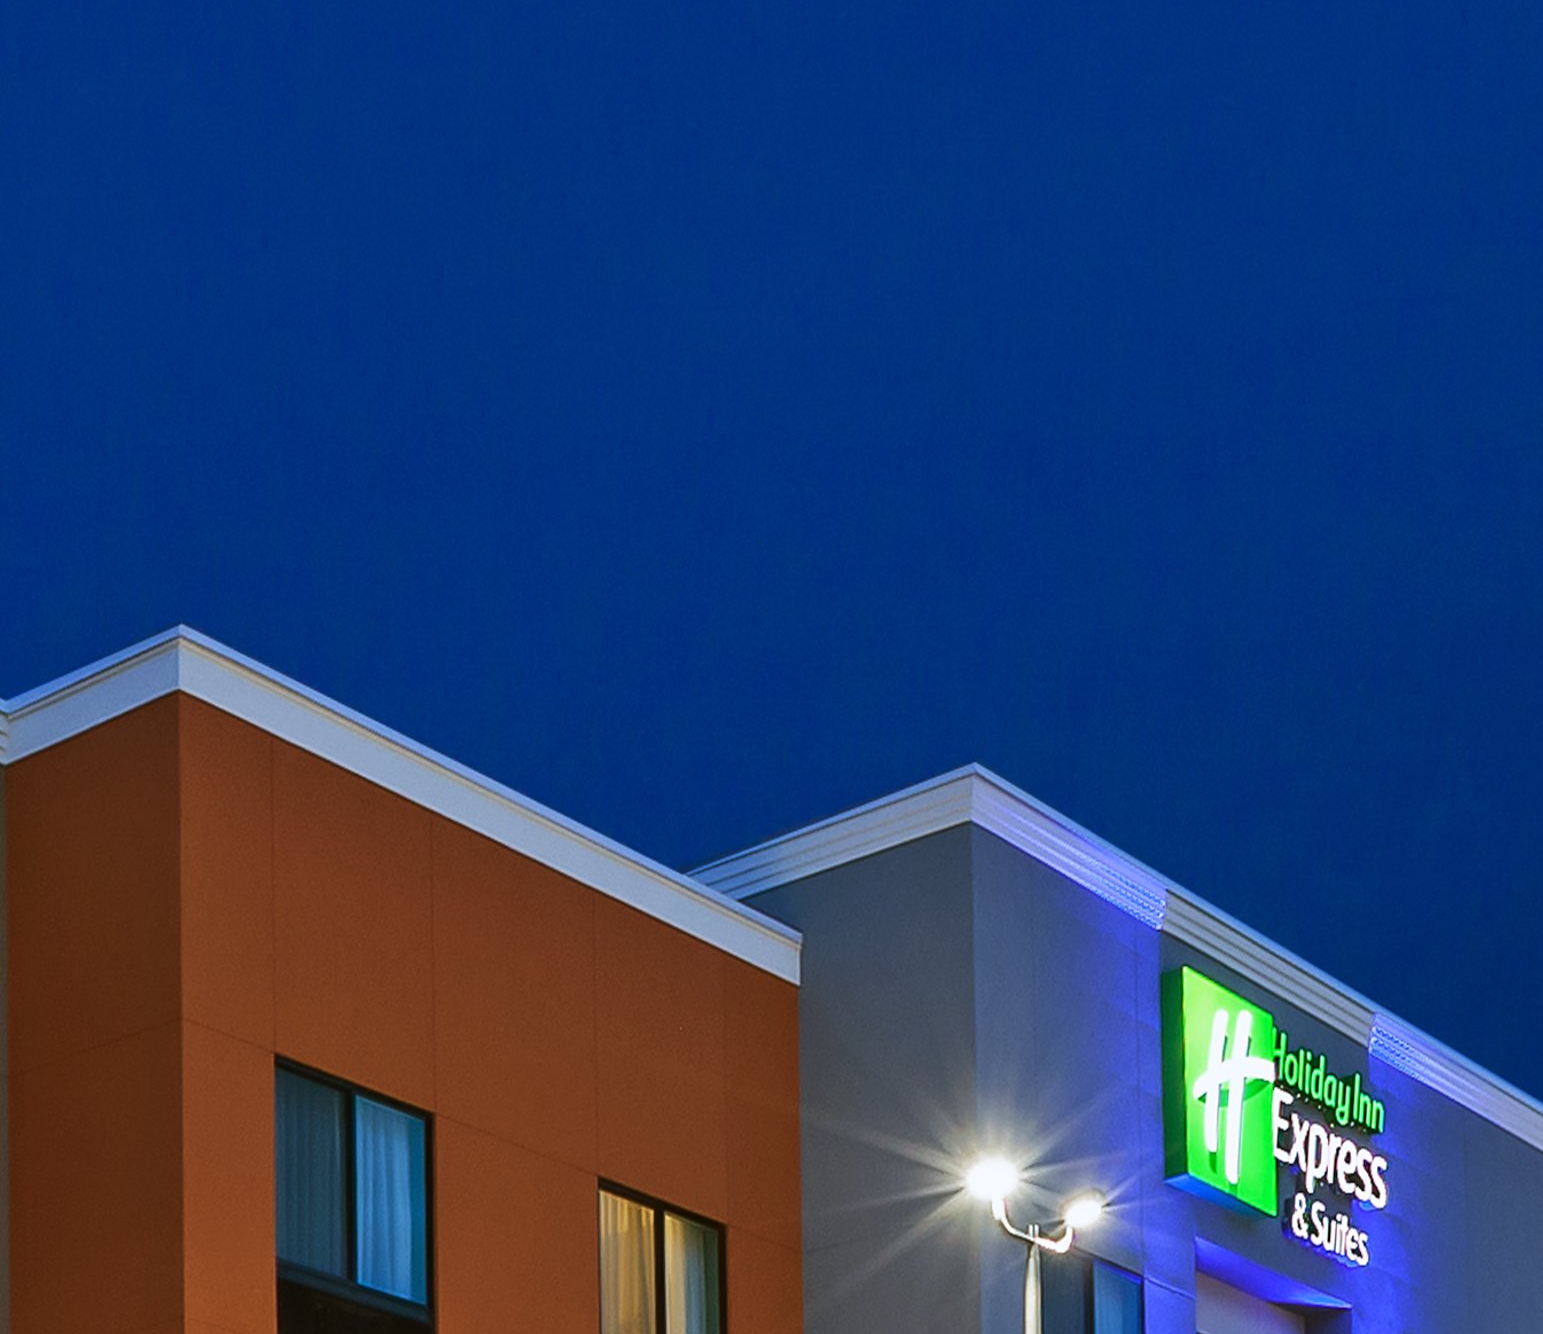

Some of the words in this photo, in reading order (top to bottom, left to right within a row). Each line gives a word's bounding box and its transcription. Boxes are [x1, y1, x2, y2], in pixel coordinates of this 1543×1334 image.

[1272, 1027, 1351, 1126] Holiday
[1353, 1073, 1385, 1133] Inn
[1272, 1087, 1387, 1209] Express
[1292, 1192, 1309, 1240] &
[1311, 1200, 1369, 1266] Suites
